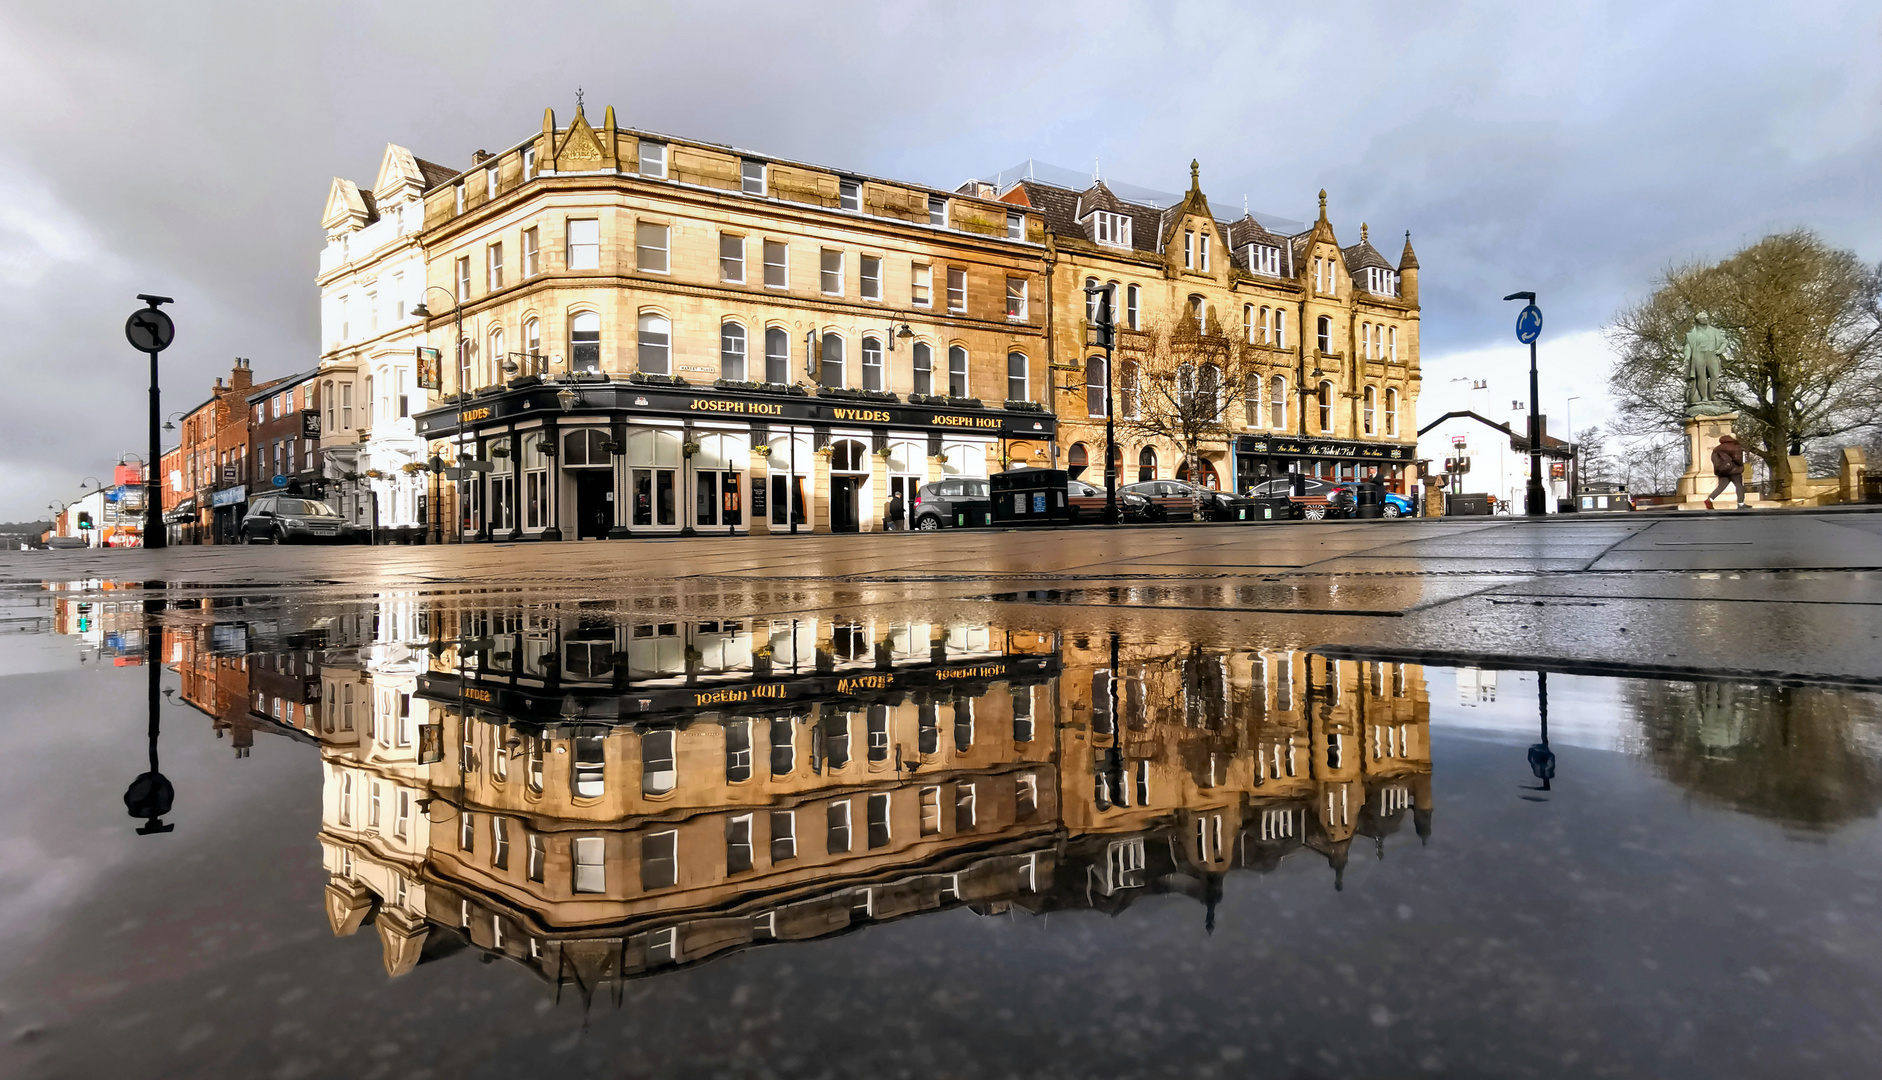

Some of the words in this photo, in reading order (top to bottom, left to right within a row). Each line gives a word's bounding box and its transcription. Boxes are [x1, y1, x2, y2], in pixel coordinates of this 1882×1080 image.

[690, 399, 744, 413] JOSEPH
[748, 403, 783, 415] HOLT
[833, 408, 890, 422] WYLDES
[932, 415, 973, 427] JOSEPH
[976, 418, 1003, 428] HOLT
